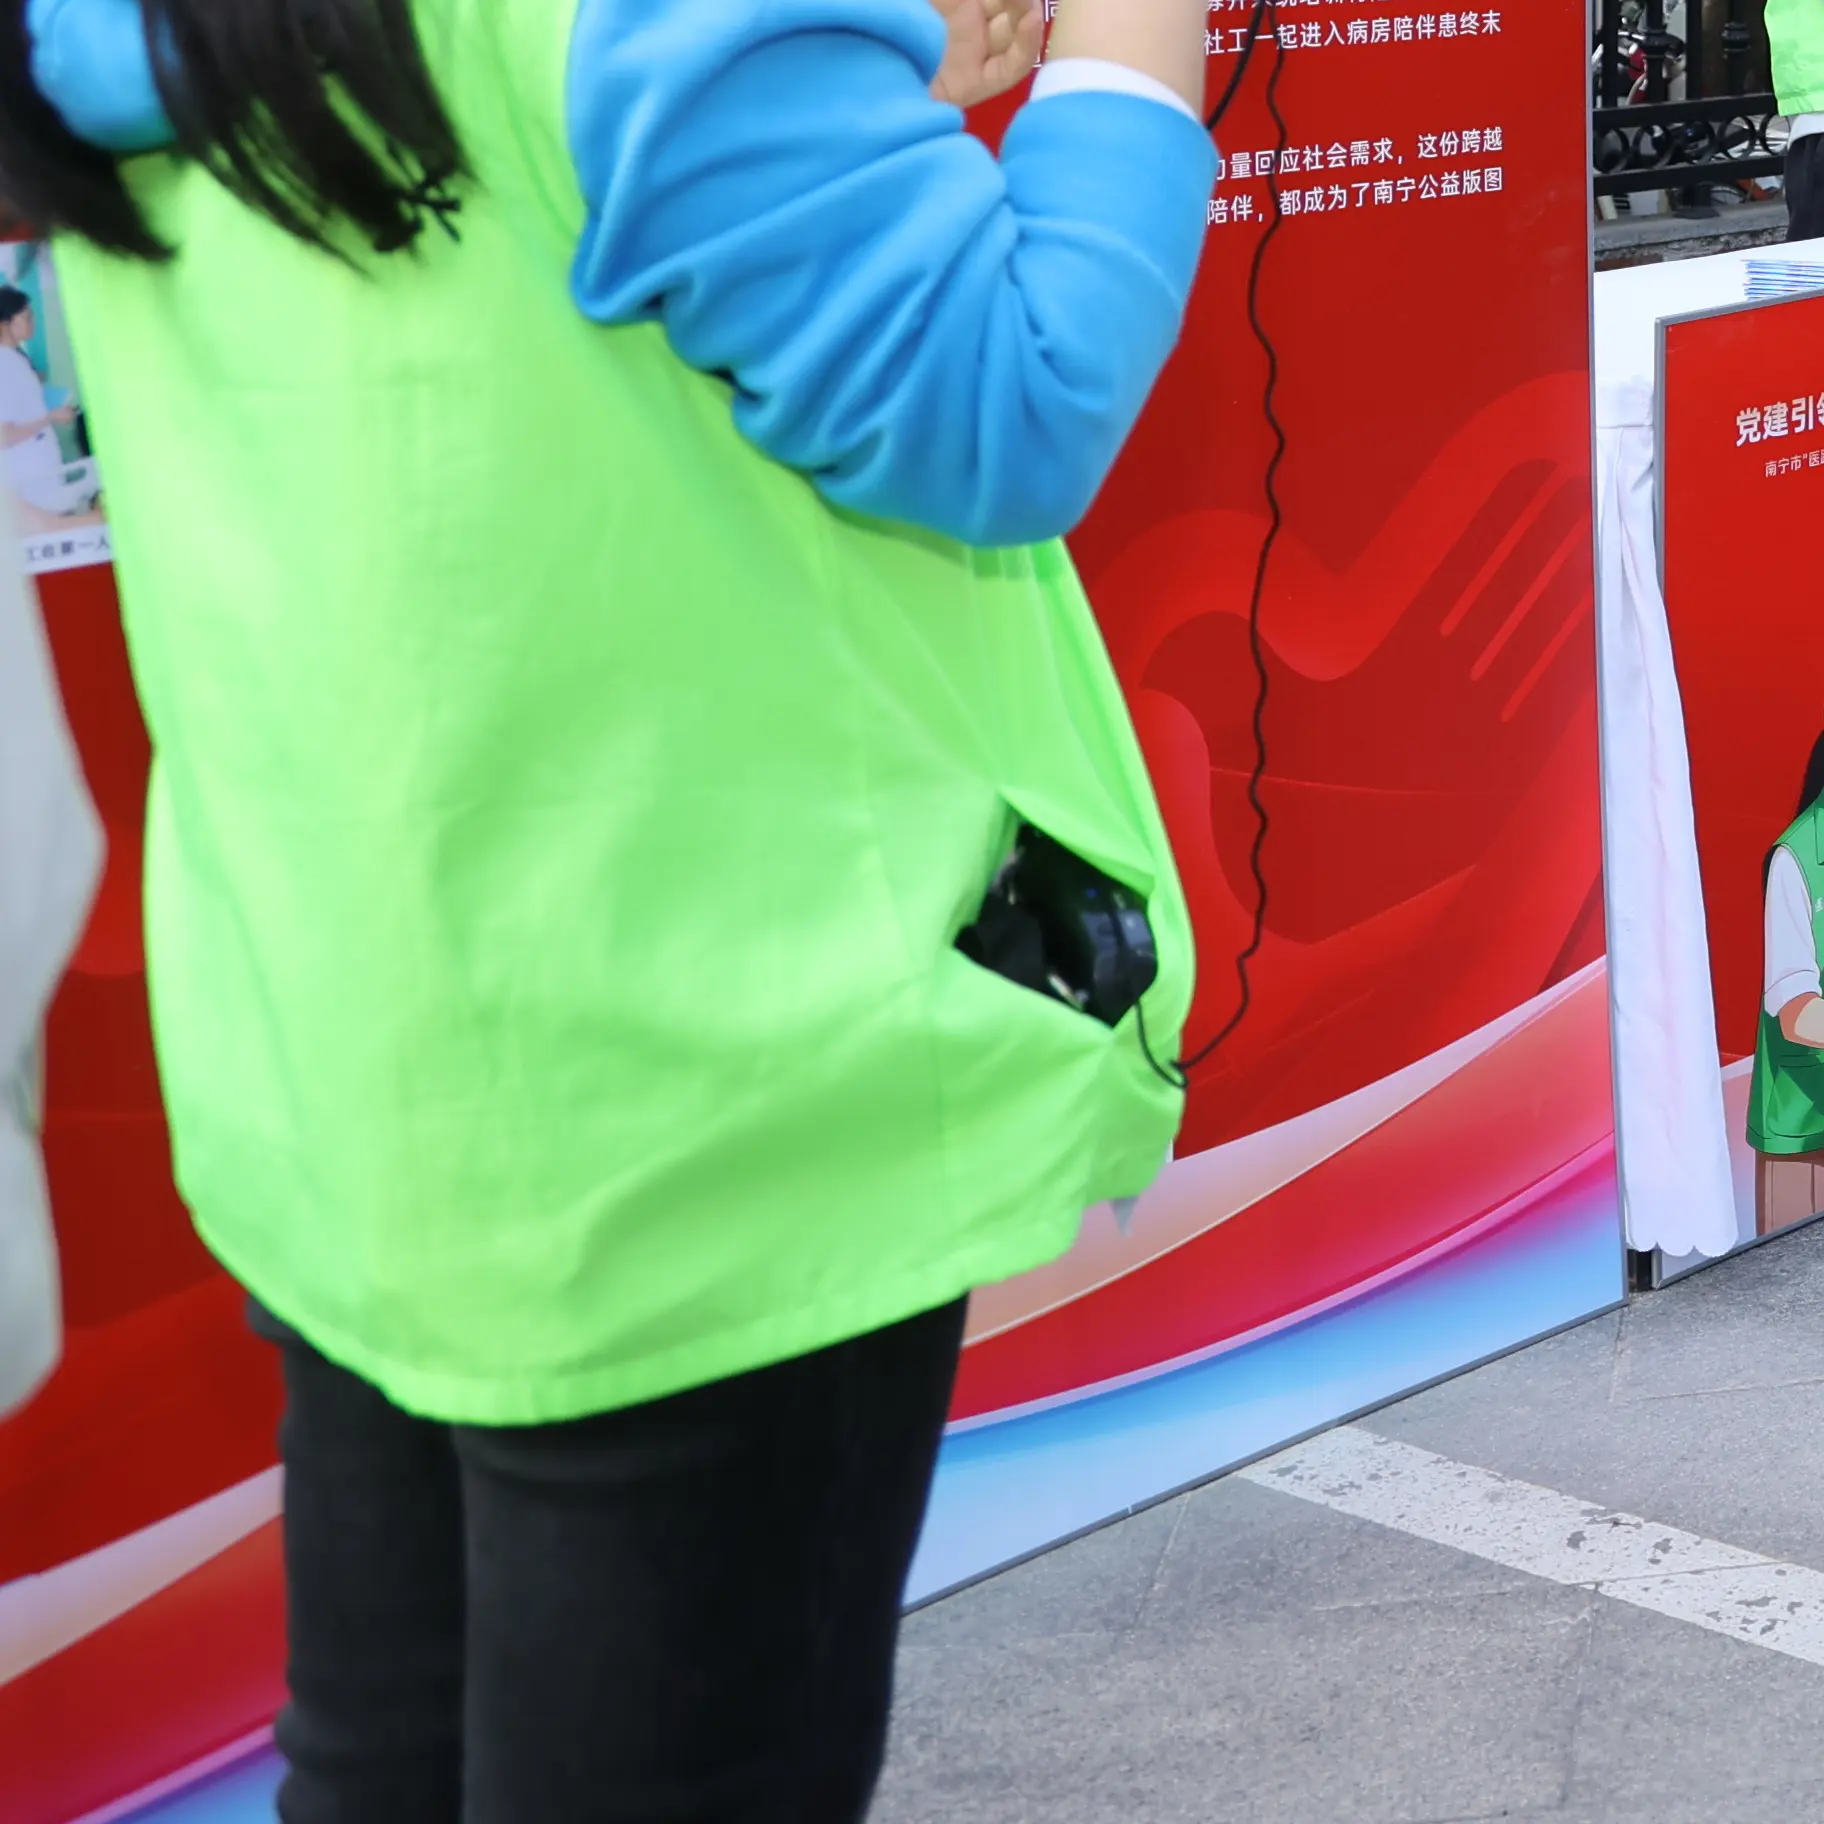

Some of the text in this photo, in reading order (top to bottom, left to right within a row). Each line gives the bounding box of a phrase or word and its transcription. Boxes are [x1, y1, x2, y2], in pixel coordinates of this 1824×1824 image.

[1207, 167, 1502, 225] 陪伴，都成为了南宁公益版图
